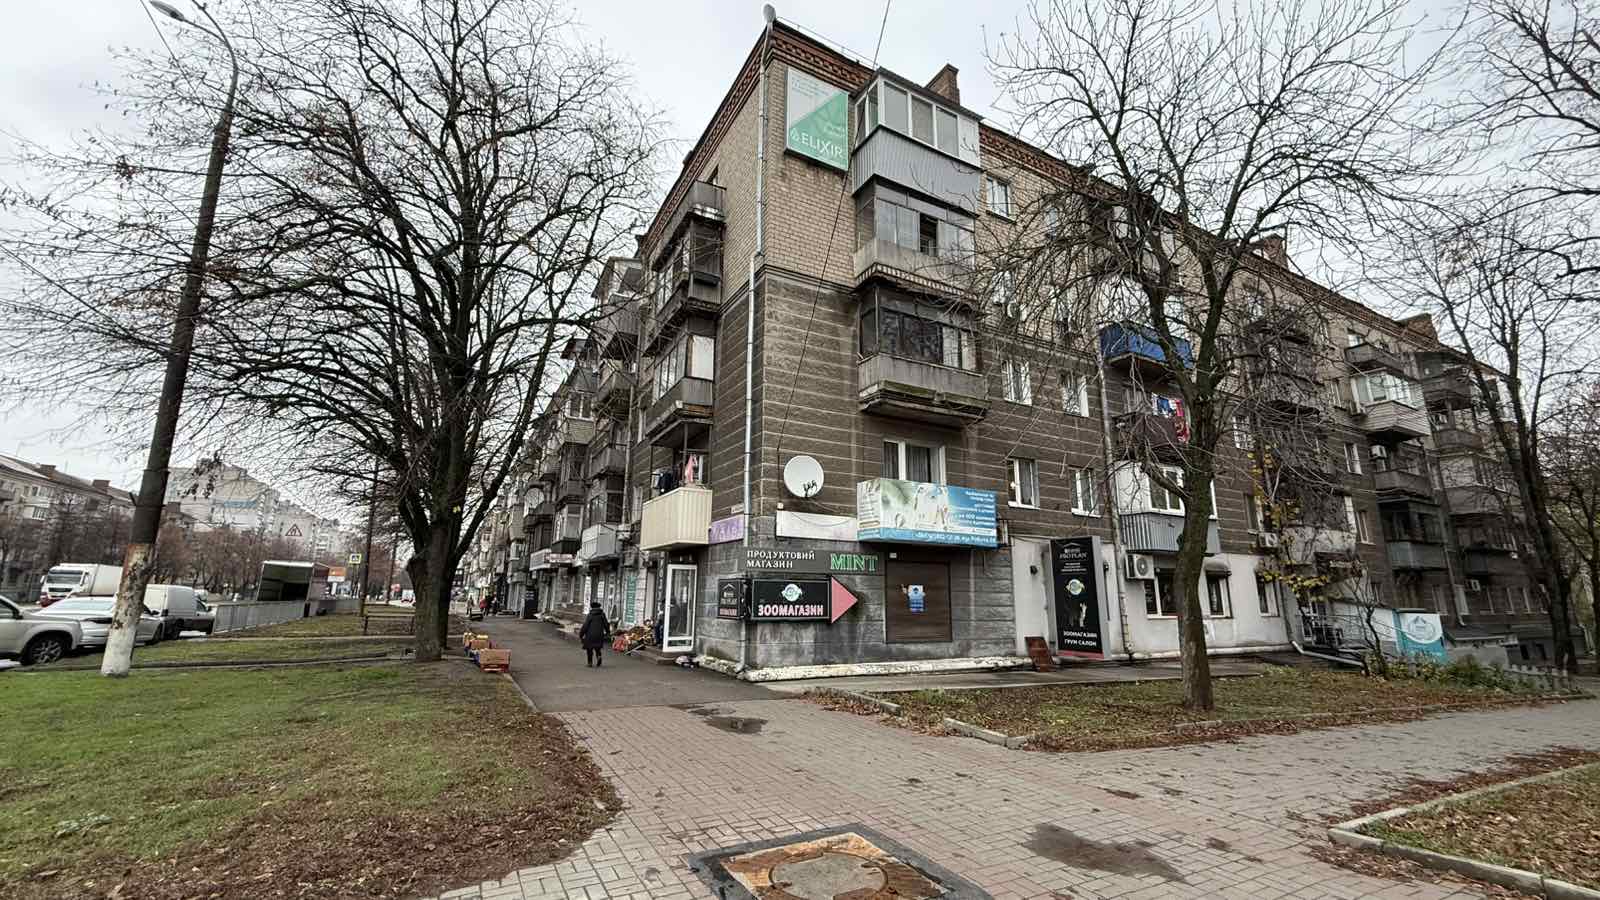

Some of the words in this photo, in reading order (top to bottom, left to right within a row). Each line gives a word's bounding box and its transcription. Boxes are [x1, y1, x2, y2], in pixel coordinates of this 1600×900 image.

[801, 132, 843, 158] ELIXIR
[746, 550, 816, 560] ПРОДУКТОВИЙ
[746, 560, 793, 568] МАГАЗИН
[830, 553, 878, 571] MINT
[758, 604, 824, 616] ЗООМАГАЗИН
